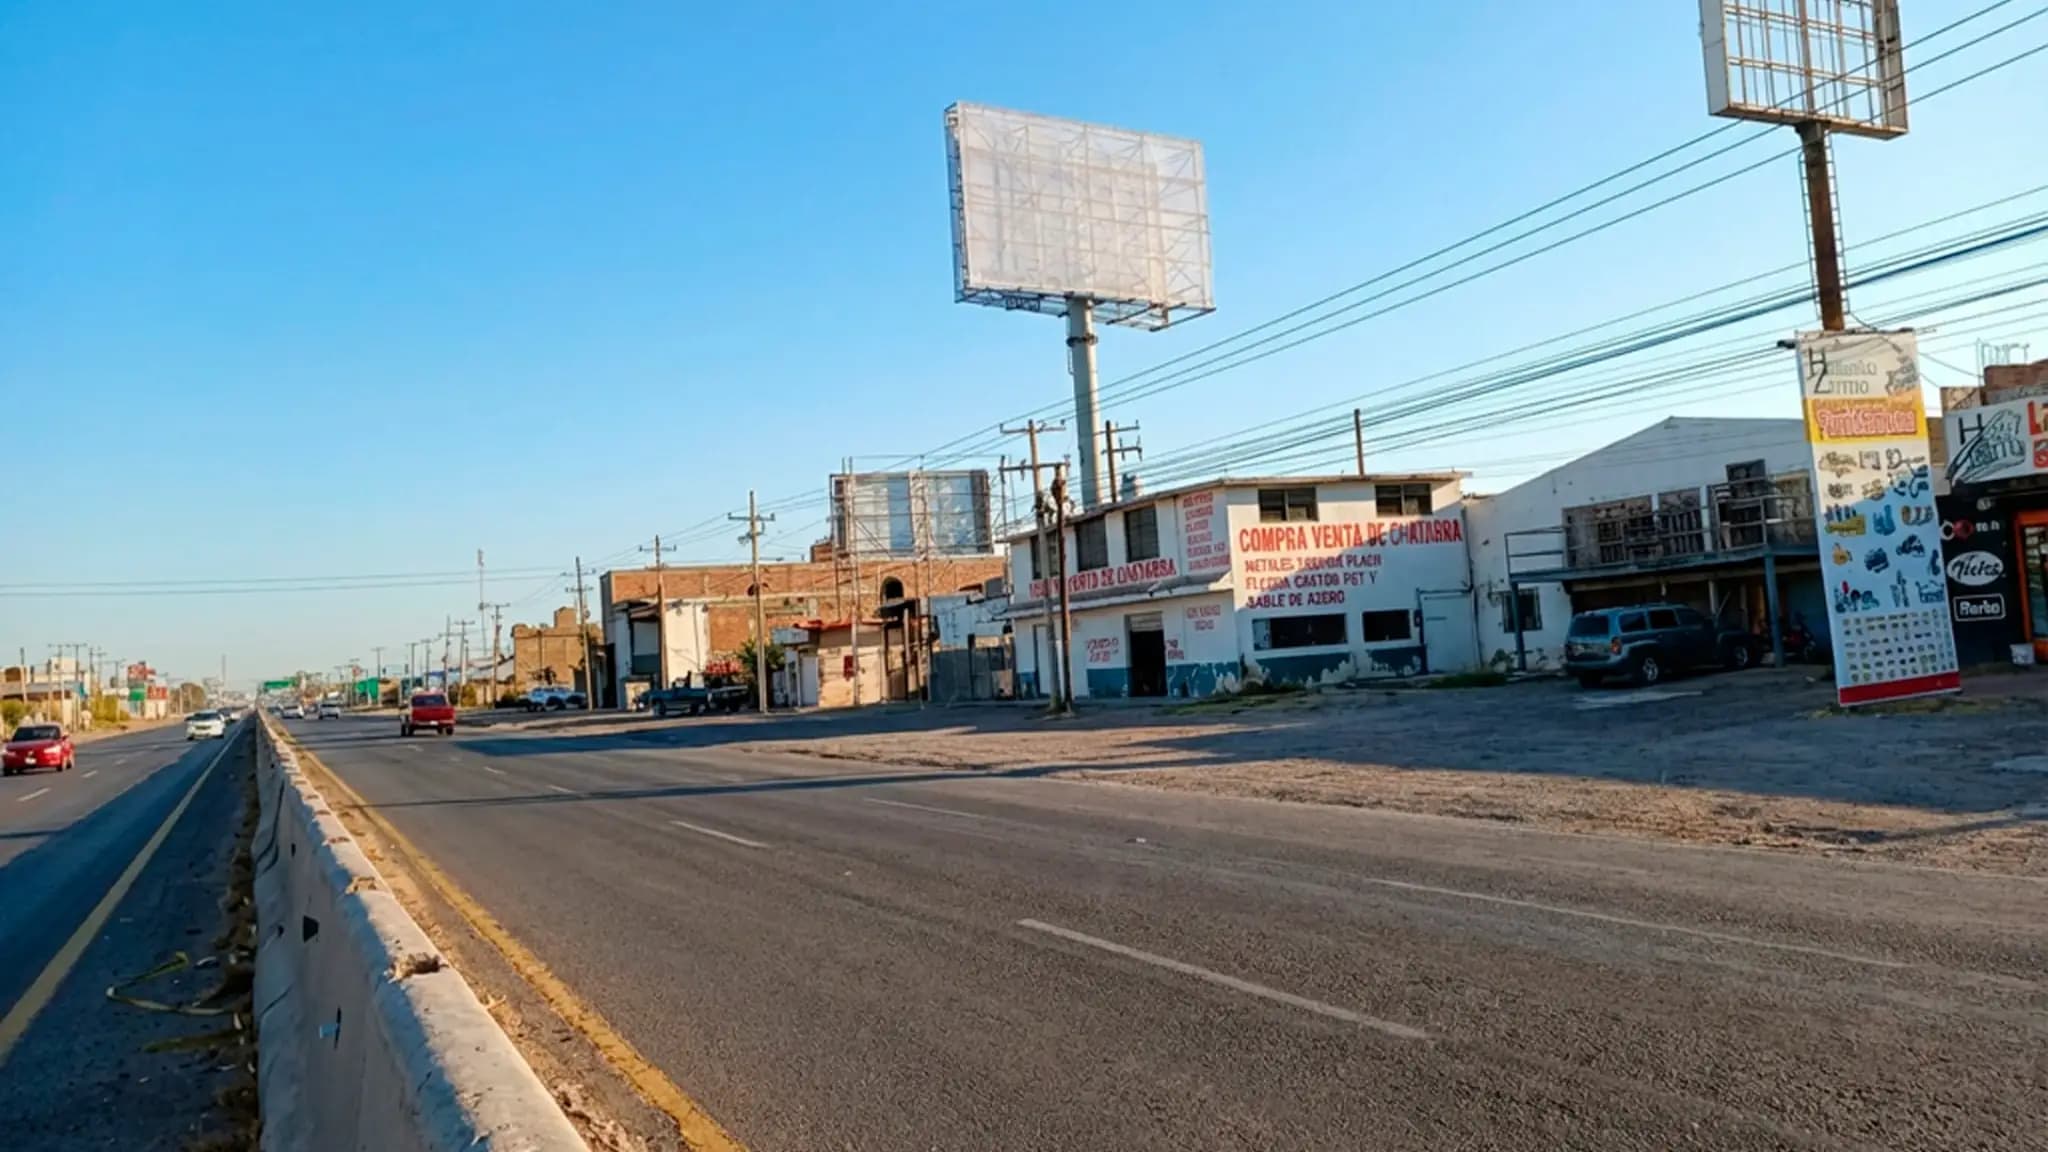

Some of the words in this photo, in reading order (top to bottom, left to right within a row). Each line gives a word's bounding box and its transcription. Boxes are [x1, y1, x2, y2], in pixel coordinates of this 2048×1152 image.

[1239, 525, 1308, 553] COMPRA
[1311, 522, 1364, 549] VENTA
[1367, 521, 1387, 547] DE
[1389, 518, 1463, 546] CHATARRA
